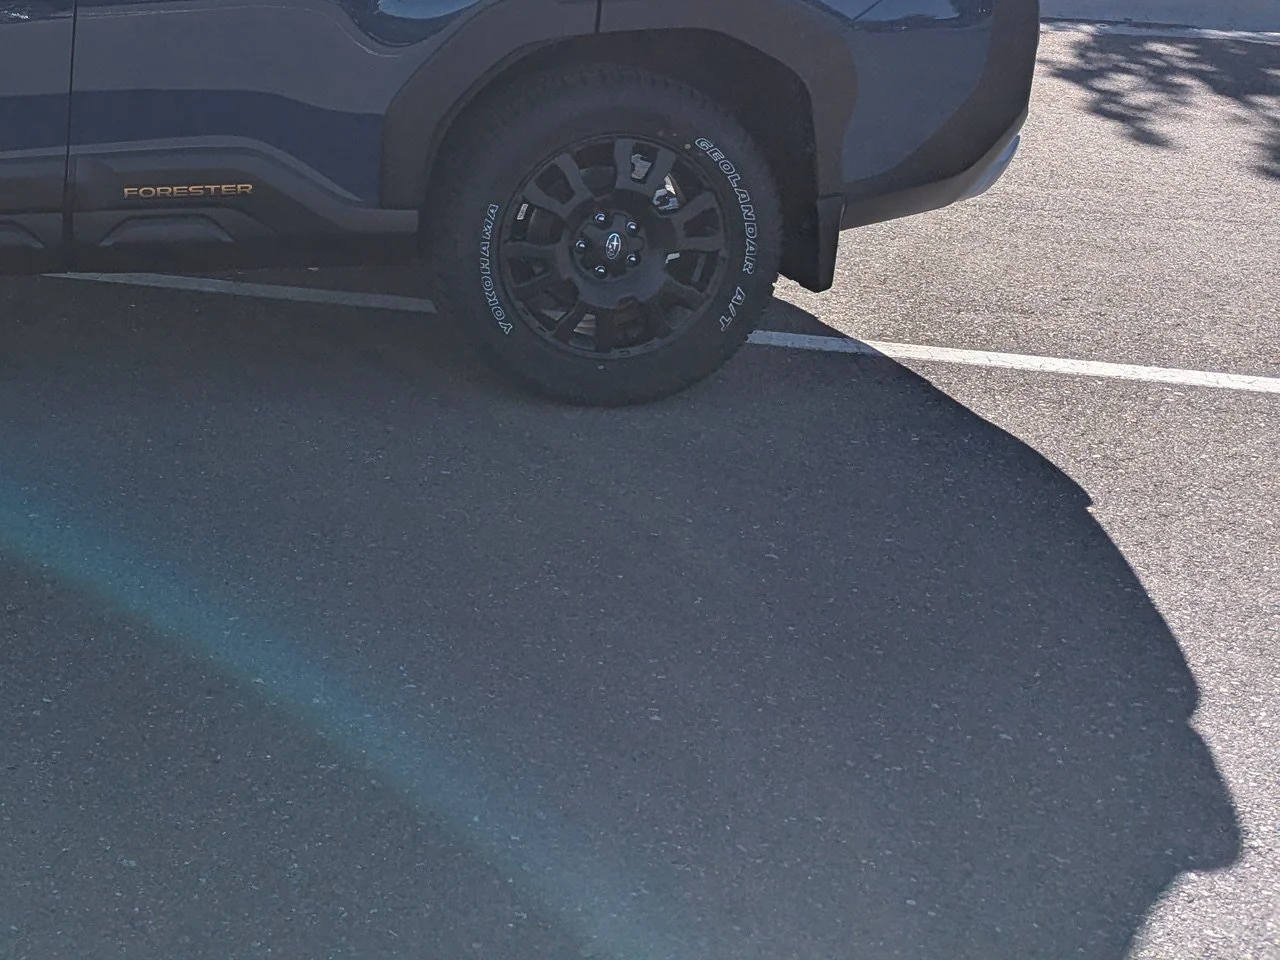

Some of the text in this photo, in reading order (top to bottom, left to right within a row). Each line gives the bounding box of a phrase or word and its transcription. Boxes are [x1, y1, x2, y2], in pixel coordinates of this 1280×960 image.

[123, 184, 253, 198] FORESTER
[695, 137, 758, 332] GEOLANDAR A/T
[480, 203, 513, 335] YOKOHAMA
